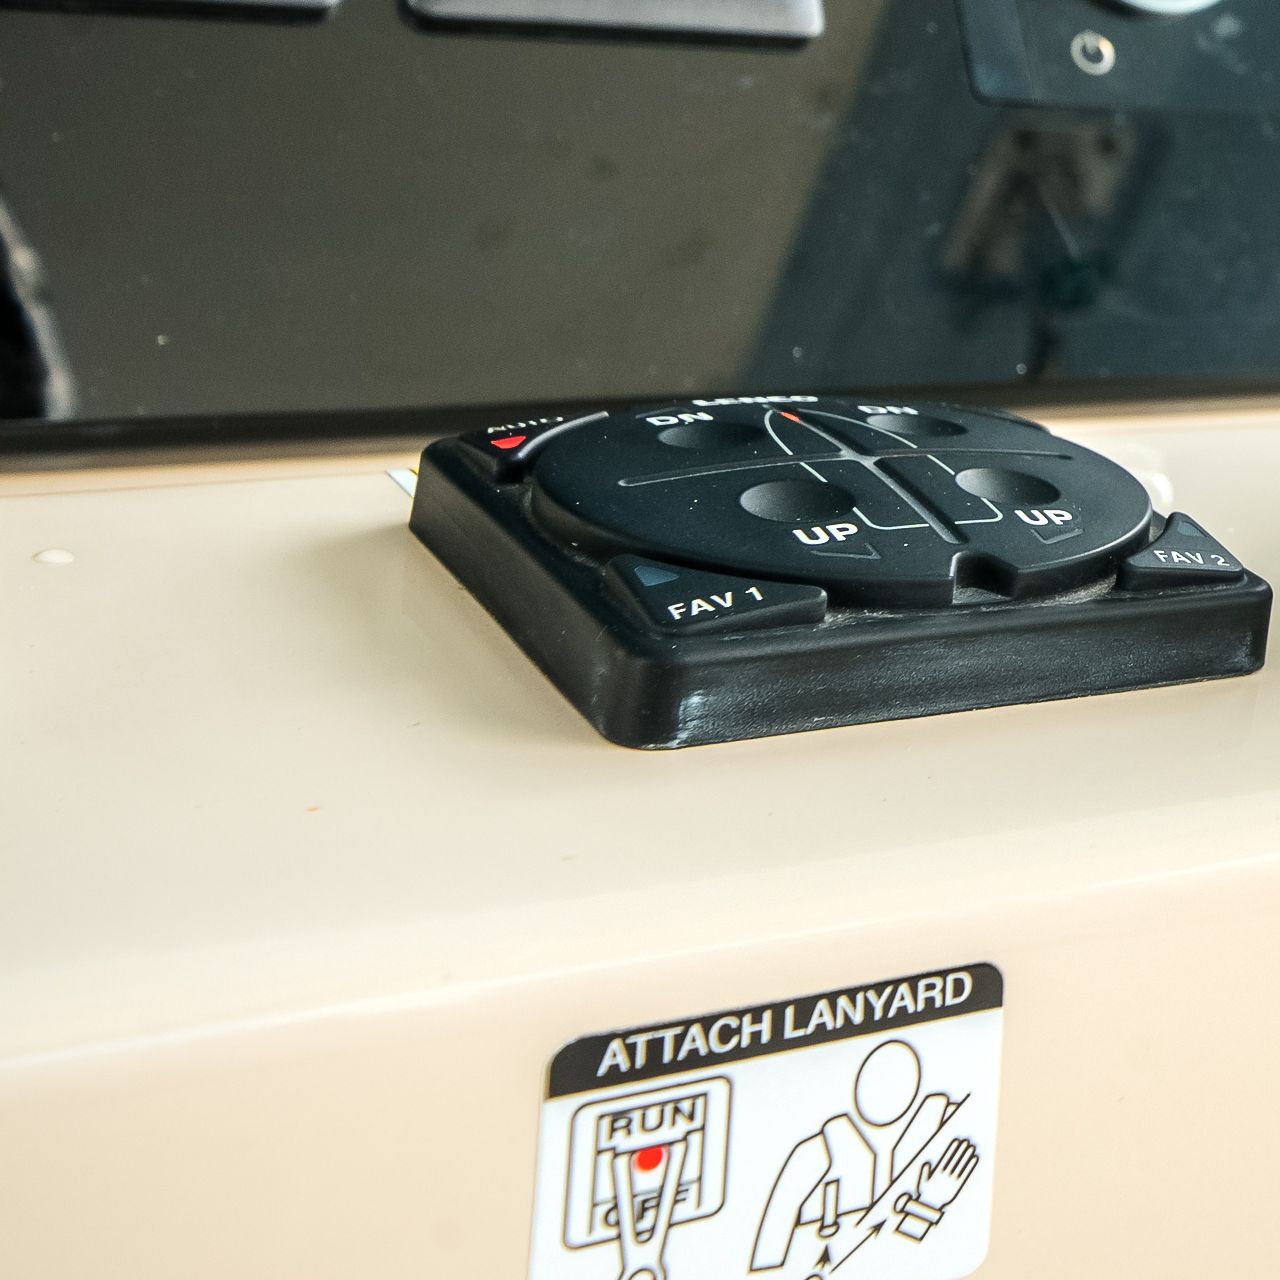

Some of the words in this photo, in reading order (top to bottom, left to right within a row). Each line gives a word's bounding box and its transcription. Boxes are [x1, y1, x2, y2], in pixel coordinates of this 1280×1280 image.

[646, 411, 713, 426] DN
[1014, 509, 1073, 526] UP
[792, 523, 858, 545] UP
[1153, 549, 1206, 566] FAV
[1211, 554, 1230, 567] 2
[667, 591, 734, 621] FAV
[745, 586, 764, 601] 1
[596, 1009, 773, 1078] ATTACH
[783, 970, 973, 1040] LANYARD
[609, 1097, 697, 1142] RUN
